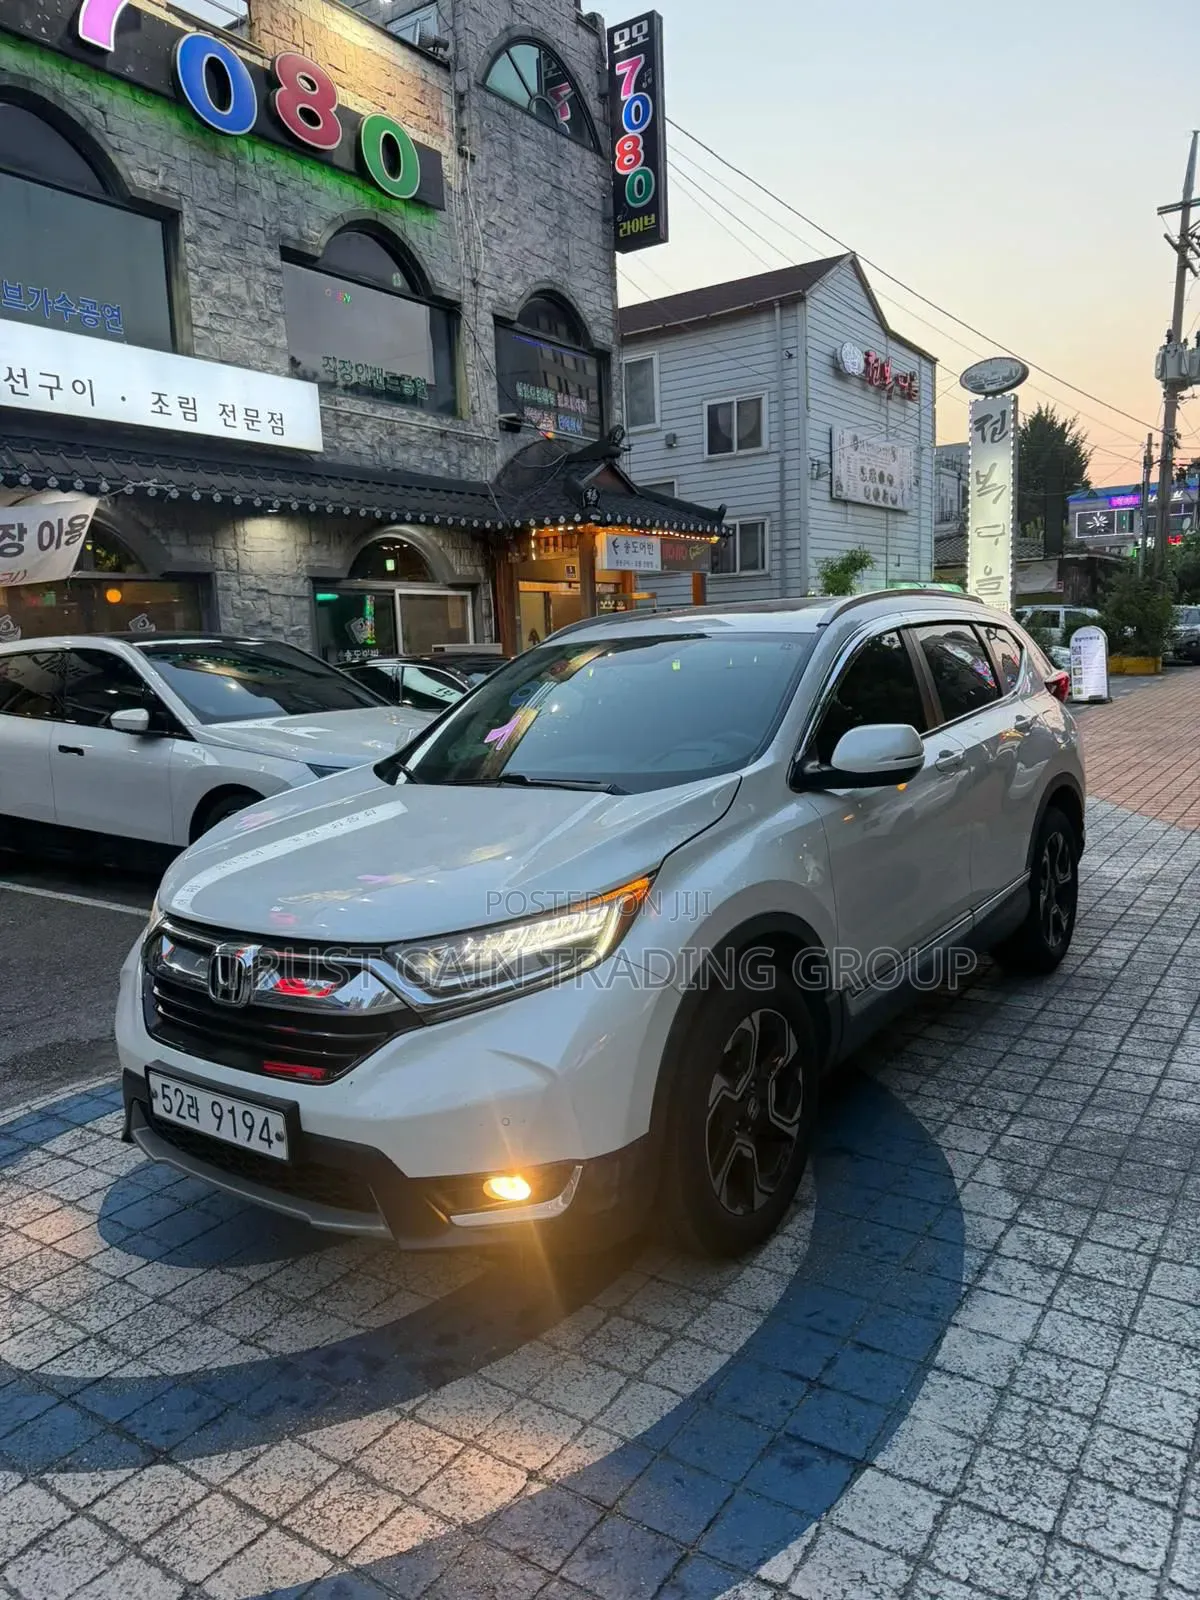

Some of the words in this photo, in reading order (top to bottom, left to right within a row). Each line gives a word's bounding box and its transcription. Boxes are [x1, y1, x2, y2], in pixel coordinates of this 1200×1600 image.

[613, 19, 650, 54] 모모
[615, 53, 656, 209] 7080
[619, 213, 657, 238] 라이브
[1, 280, 124, 335] 브가수공연
[3, 366, 96, 408] 선구이
[150, 391, 199, 423] 조림
[217, 402, 286, 437] 전문점
[321, 355, 430, 401] 직장인밴드공연
[37, 513, 91, 552] 이용
[160, 1083, 200, 1124] 52라
[210, 1100, 274, 1149] 9194
